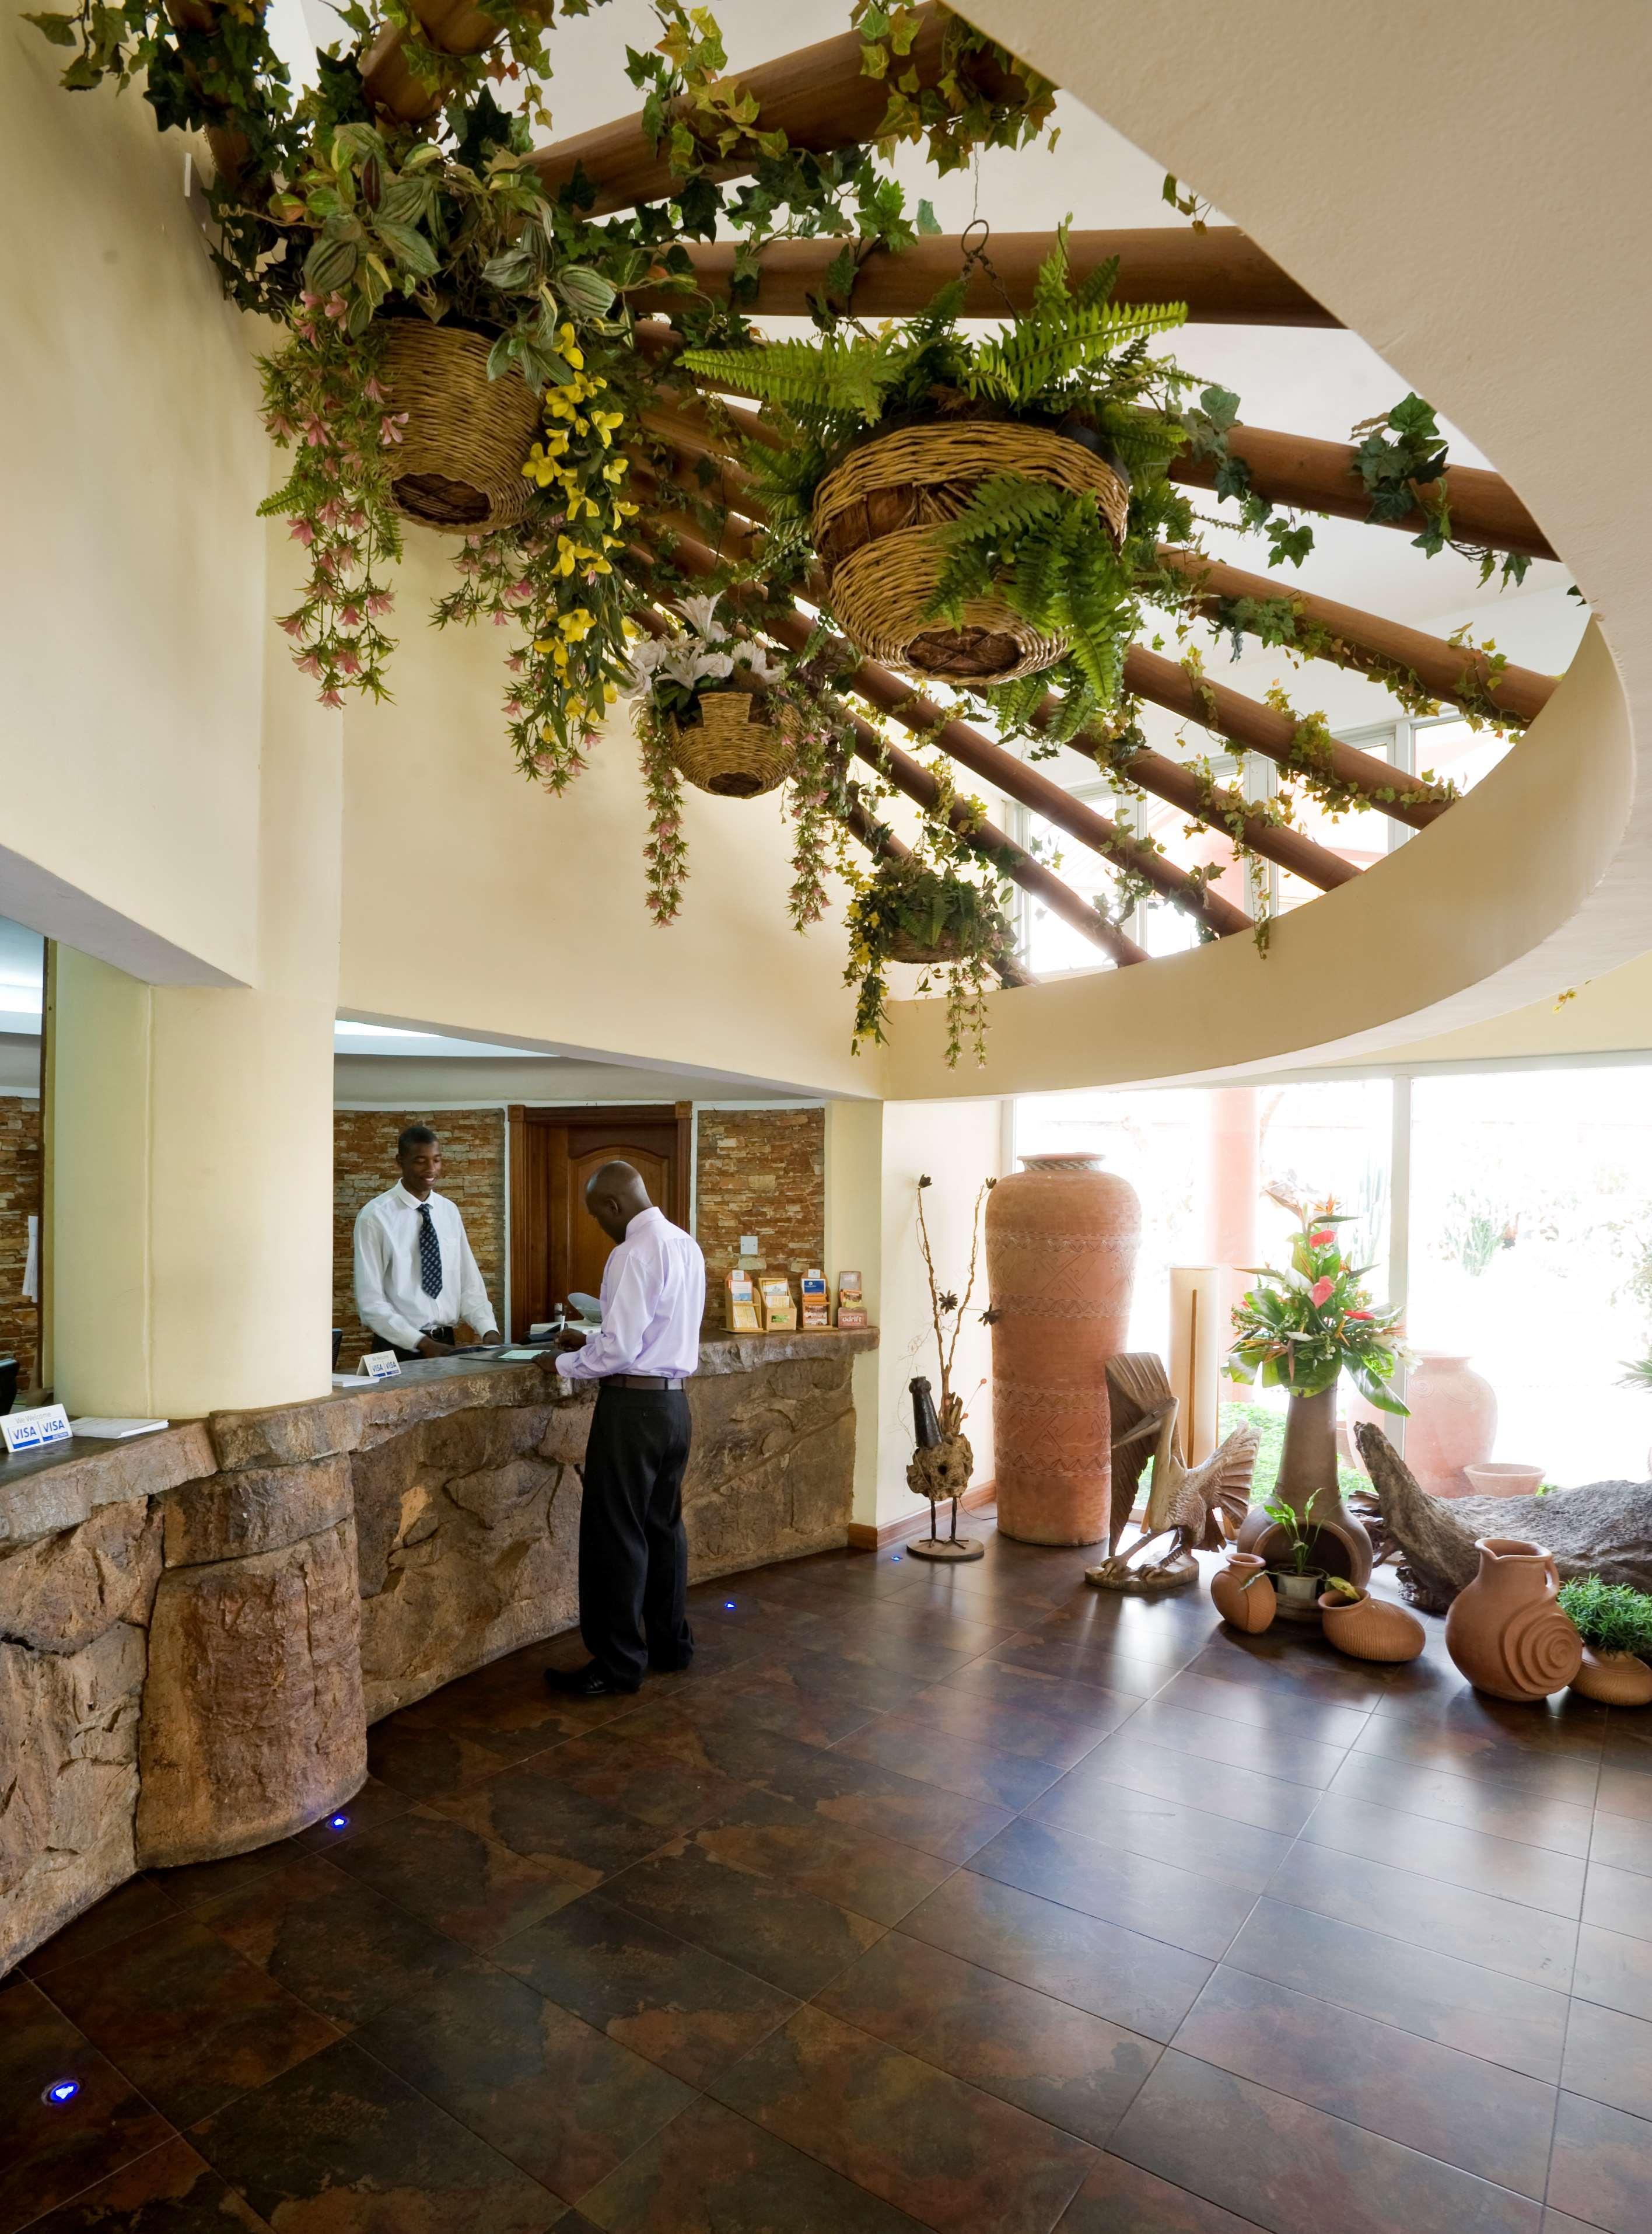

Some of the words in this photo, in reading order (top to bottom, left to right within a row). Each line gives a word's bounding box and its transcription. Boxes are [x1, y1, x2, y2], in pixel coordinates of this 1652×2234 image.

[373, 1364, 383, 1372] VISA
[386, 1361, 397, 1369] VISA
[26, 1412, 51, 1421] Welcome
[13, 1426, 37, 1440] VISA
[43, 1420, 65, 1433] VISA
